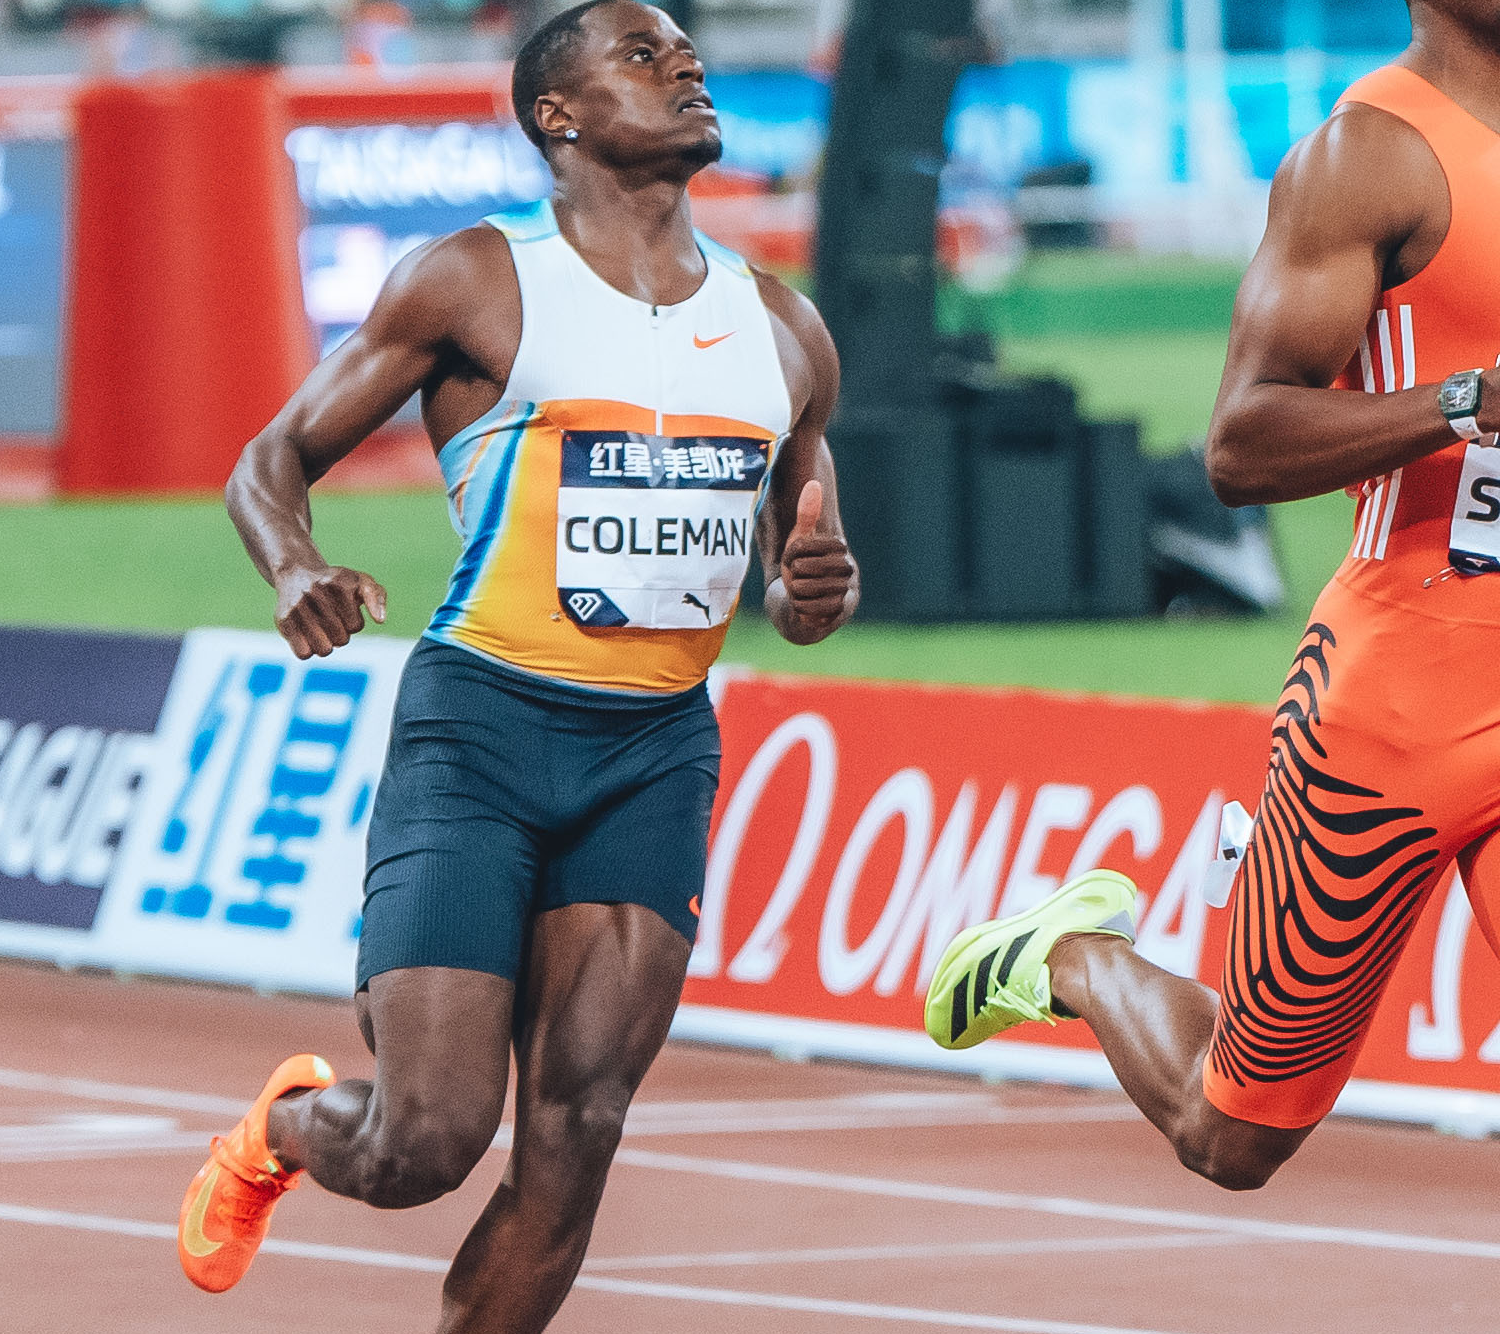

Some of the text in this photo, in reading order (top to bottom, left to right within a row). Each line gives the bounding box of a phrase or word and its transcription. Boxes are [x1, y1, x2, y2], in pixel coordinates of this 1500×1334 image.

[589, 441, 746, 481] 红星·美凯龙
[564, 515, 747, 558] COLEMAN
